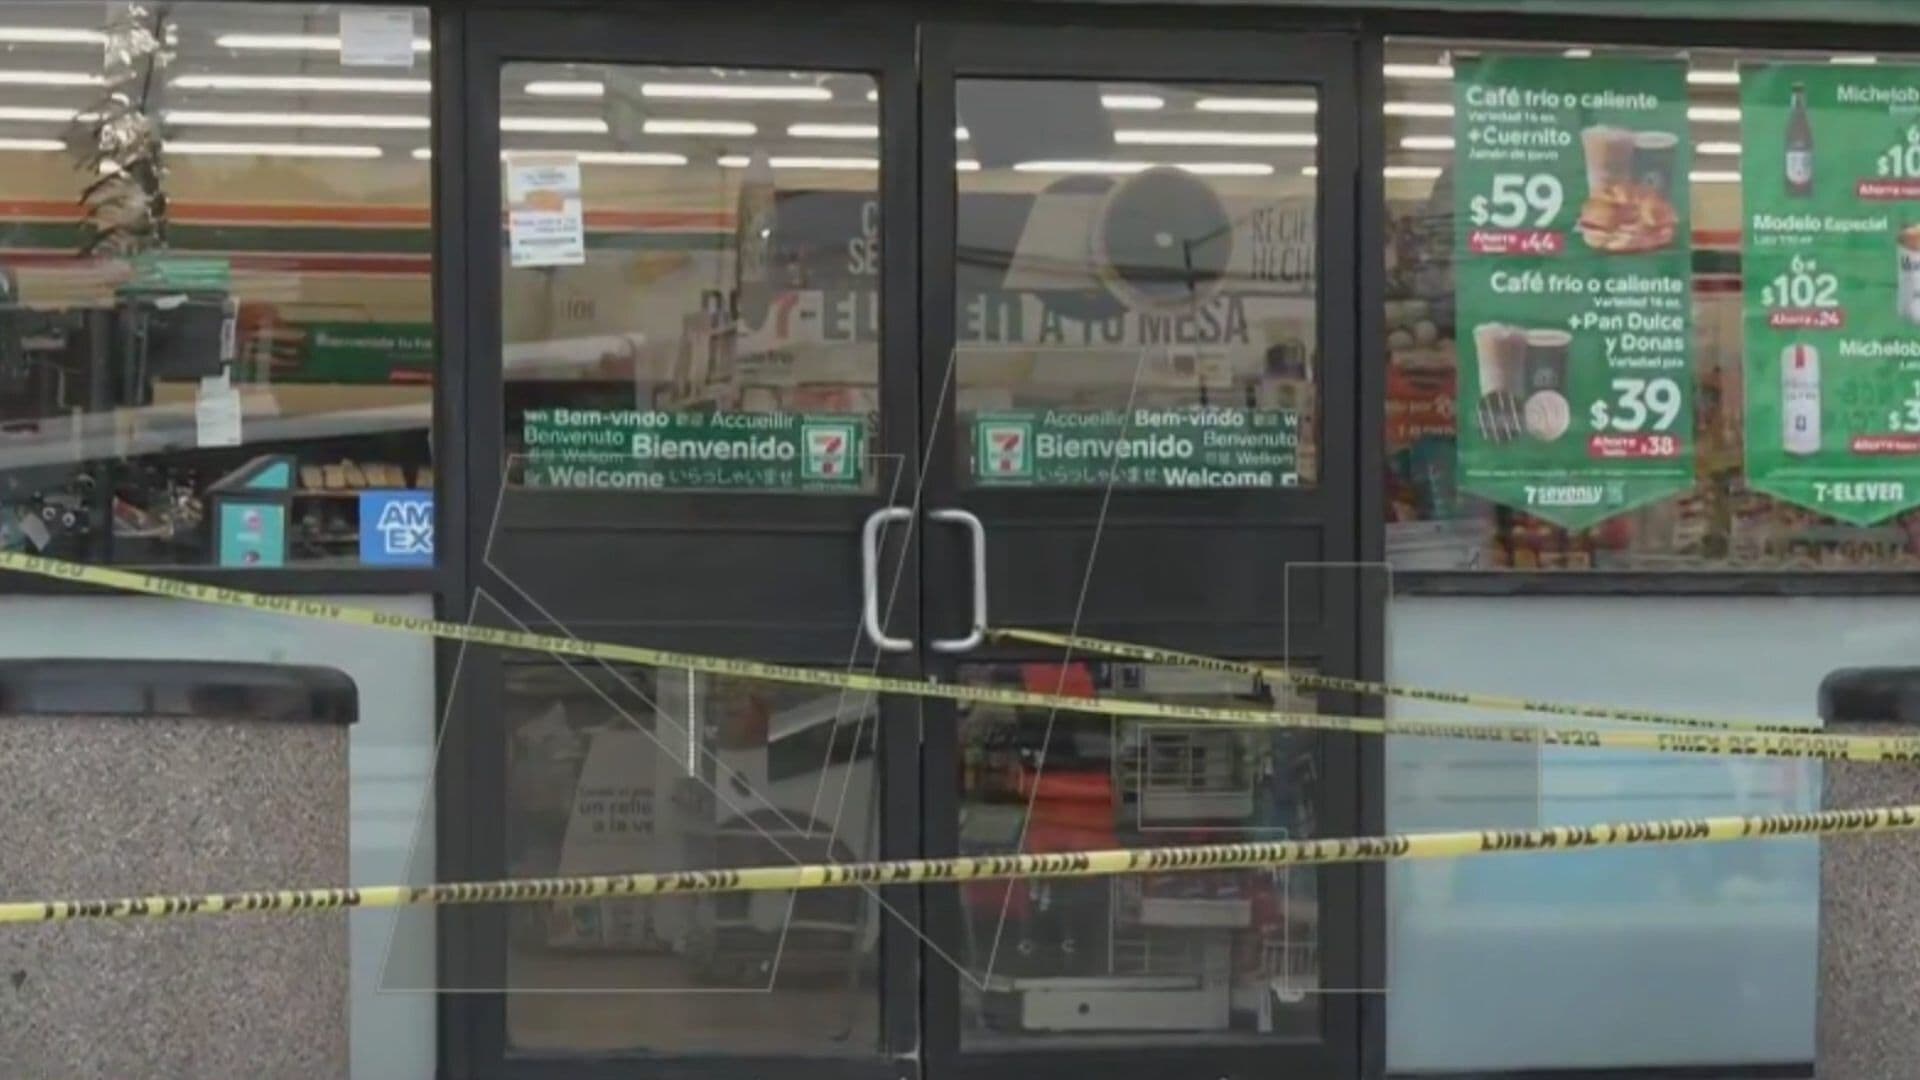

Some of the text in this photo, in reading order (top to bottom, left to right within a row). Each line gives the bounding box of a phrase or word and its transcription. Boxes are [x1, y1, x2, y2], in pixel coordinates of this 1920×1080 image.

[1466, 85, 1519, 106] Café
[1563, 95, 1576, 107] o
[1580, 90, 1657, 110] caliente
[1837, 85, 1920, 103] Michelob
[1470, 173, 1563, 228] $59
[1753, 214, 1887, 232] Modelo Especial
[1490, 271, 1543, 293] Café
[1587, 279, 1600, 293] o
[1605, 275, 1683, 293] caliente
[1761, 273, 1839, 307] $102
[1628, 313, 1683, 331] Dulce
[1605, 333, 1683, 355] y Donas
[1840, 339, 1920, 357] Michelob
[1590, 378, 1681, 431] $39
[554, 408, 669, 427] Bem-vindo
[1135, 408, 1245, 427] Bem-vindo
[524, 425, 625, 444] Benvenuto
[1203, 429, 1297, 447] Benvenuto
[632, 433, 794, 460] Bienvenido
[1036, 433, 1193, 459] Bienvenido
[549, 466, 664, 488] Welcome
[1164, 467, 1273, 487] Welcome
